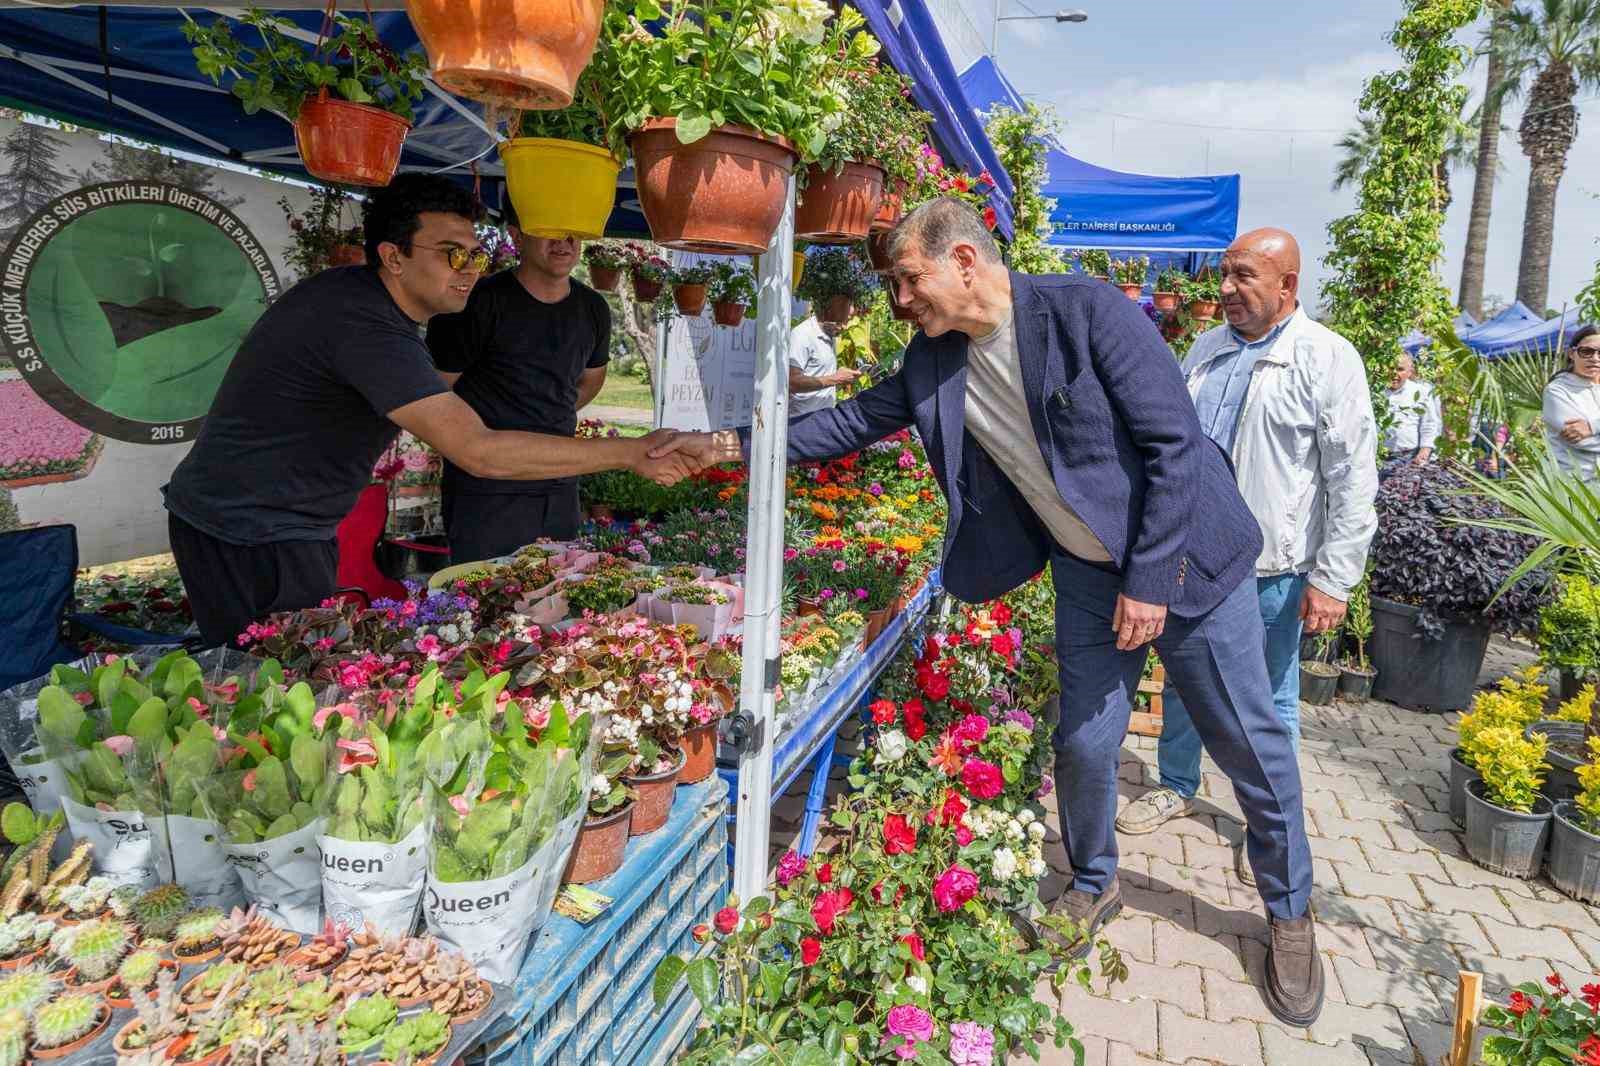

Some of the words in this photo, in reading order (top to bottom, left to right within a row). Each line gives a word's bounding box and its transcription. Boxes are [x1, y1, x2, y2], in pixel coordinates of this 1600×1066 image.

[55, 194, 89, 221] SÜS
[88, 184, 165, 207] BİTKİLERİ
[168, 188, 219, 220] ÜRETİM
[219, 214, 236, 232] VE
[3, 214, 59, 289] MENDERES
[232, 227, 278, 298] PAZARLAMA
[0, 292, 29, 345] KÜÇÜK
[151, 426, 184, 440] 2015
[320, 852, 383, 873] ueen
